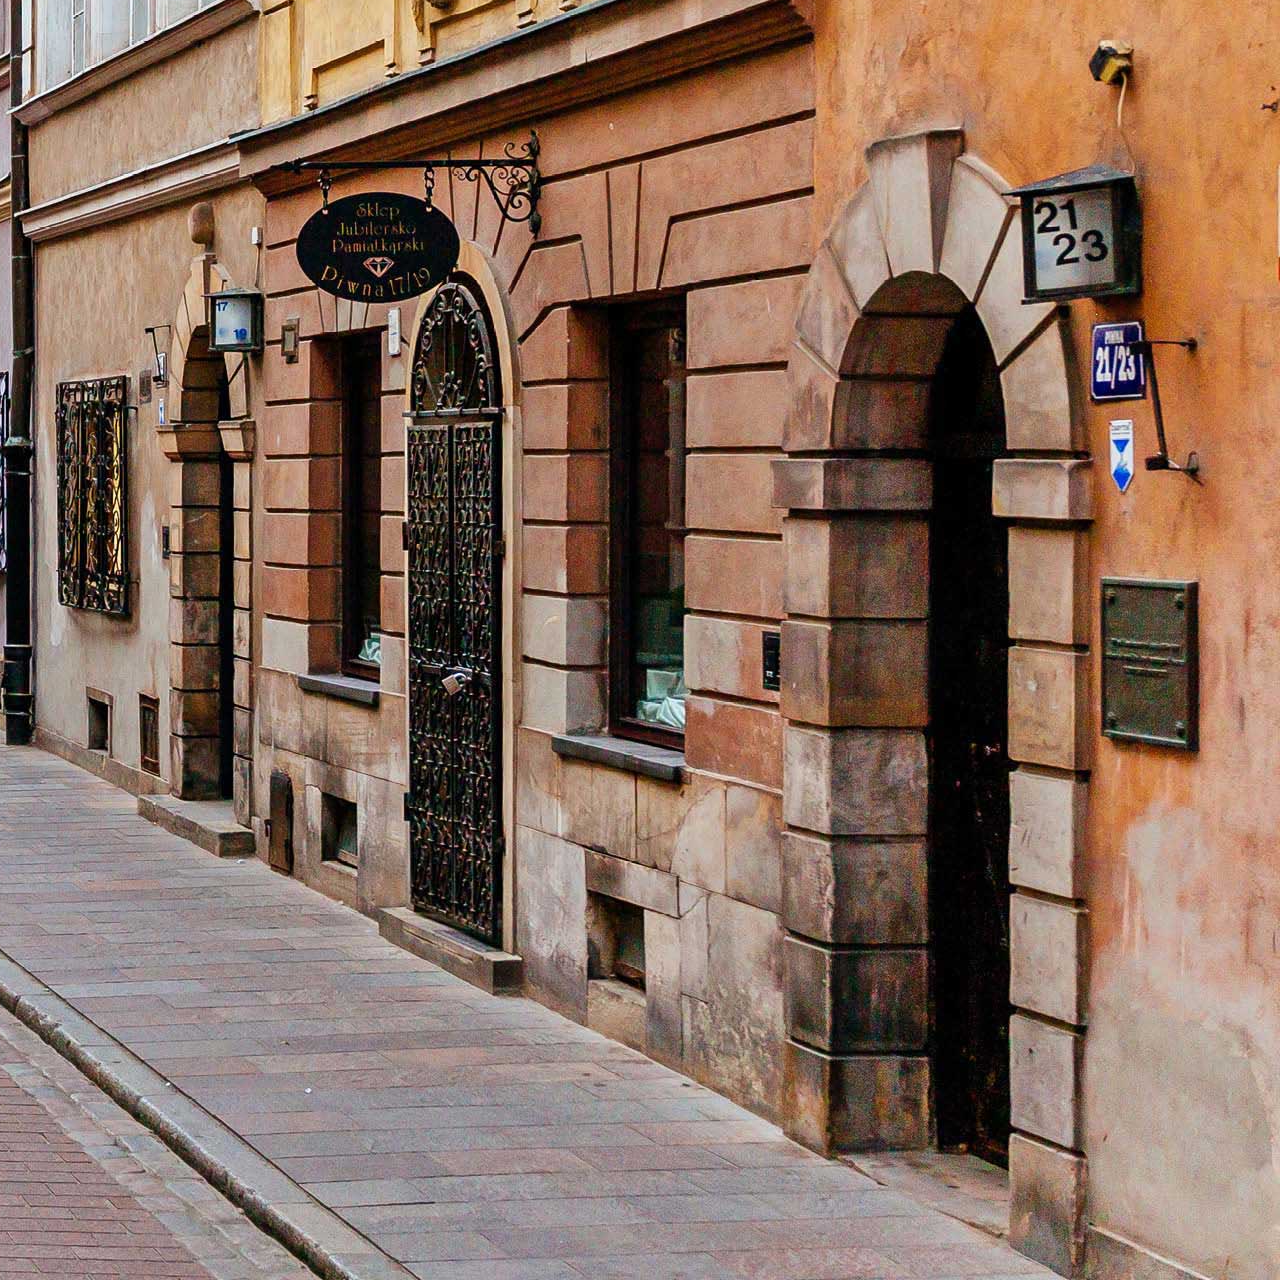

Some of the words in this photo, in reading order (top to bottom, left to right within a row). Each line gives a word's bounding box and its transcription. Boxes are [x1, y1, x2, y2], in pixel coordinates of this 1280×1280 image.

[356, 202, 401, 220] Sklep
[1034, 200, 1077, 234] 21
[1053, 229, 1109, 266] 23
[321, 265, 384, 297] Piwna
[233, 328, 248, 341] 19
[1096, 345, 1136, 389] 21/23
